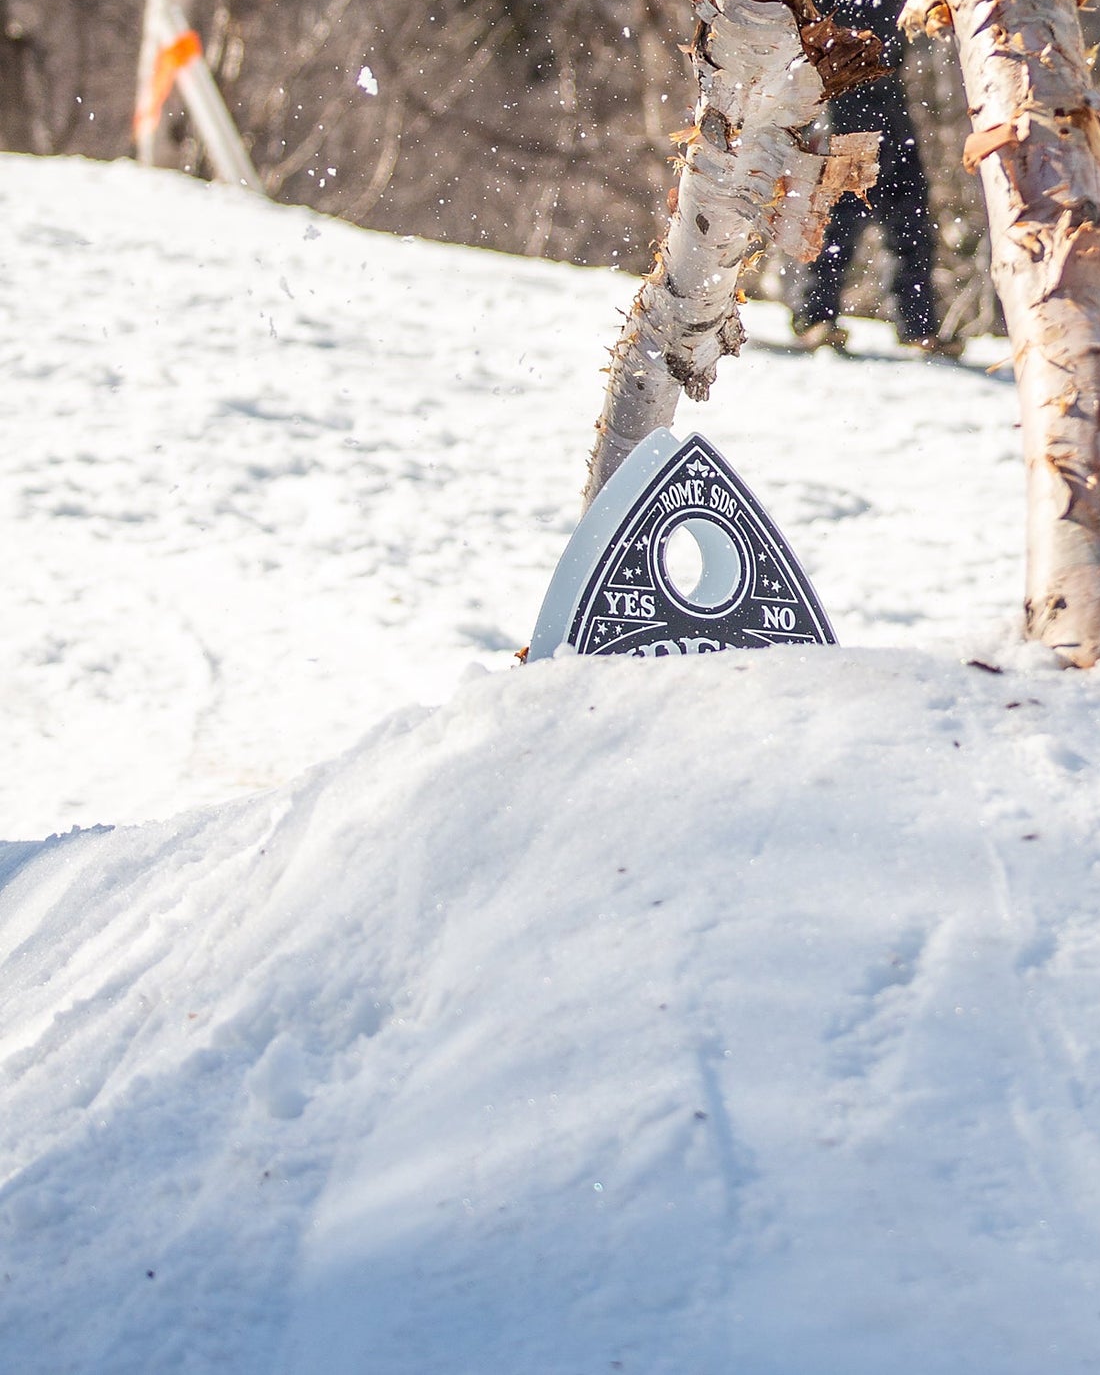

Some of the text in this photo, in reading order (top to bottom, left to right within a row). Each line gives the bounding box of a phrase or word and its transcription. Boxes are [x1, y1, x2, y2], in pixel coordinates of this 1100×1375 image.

[659, 479, 737, 518] ROME SDS
[603, 590, 656, 618] YES
[761, 605, 796, 631] NO
